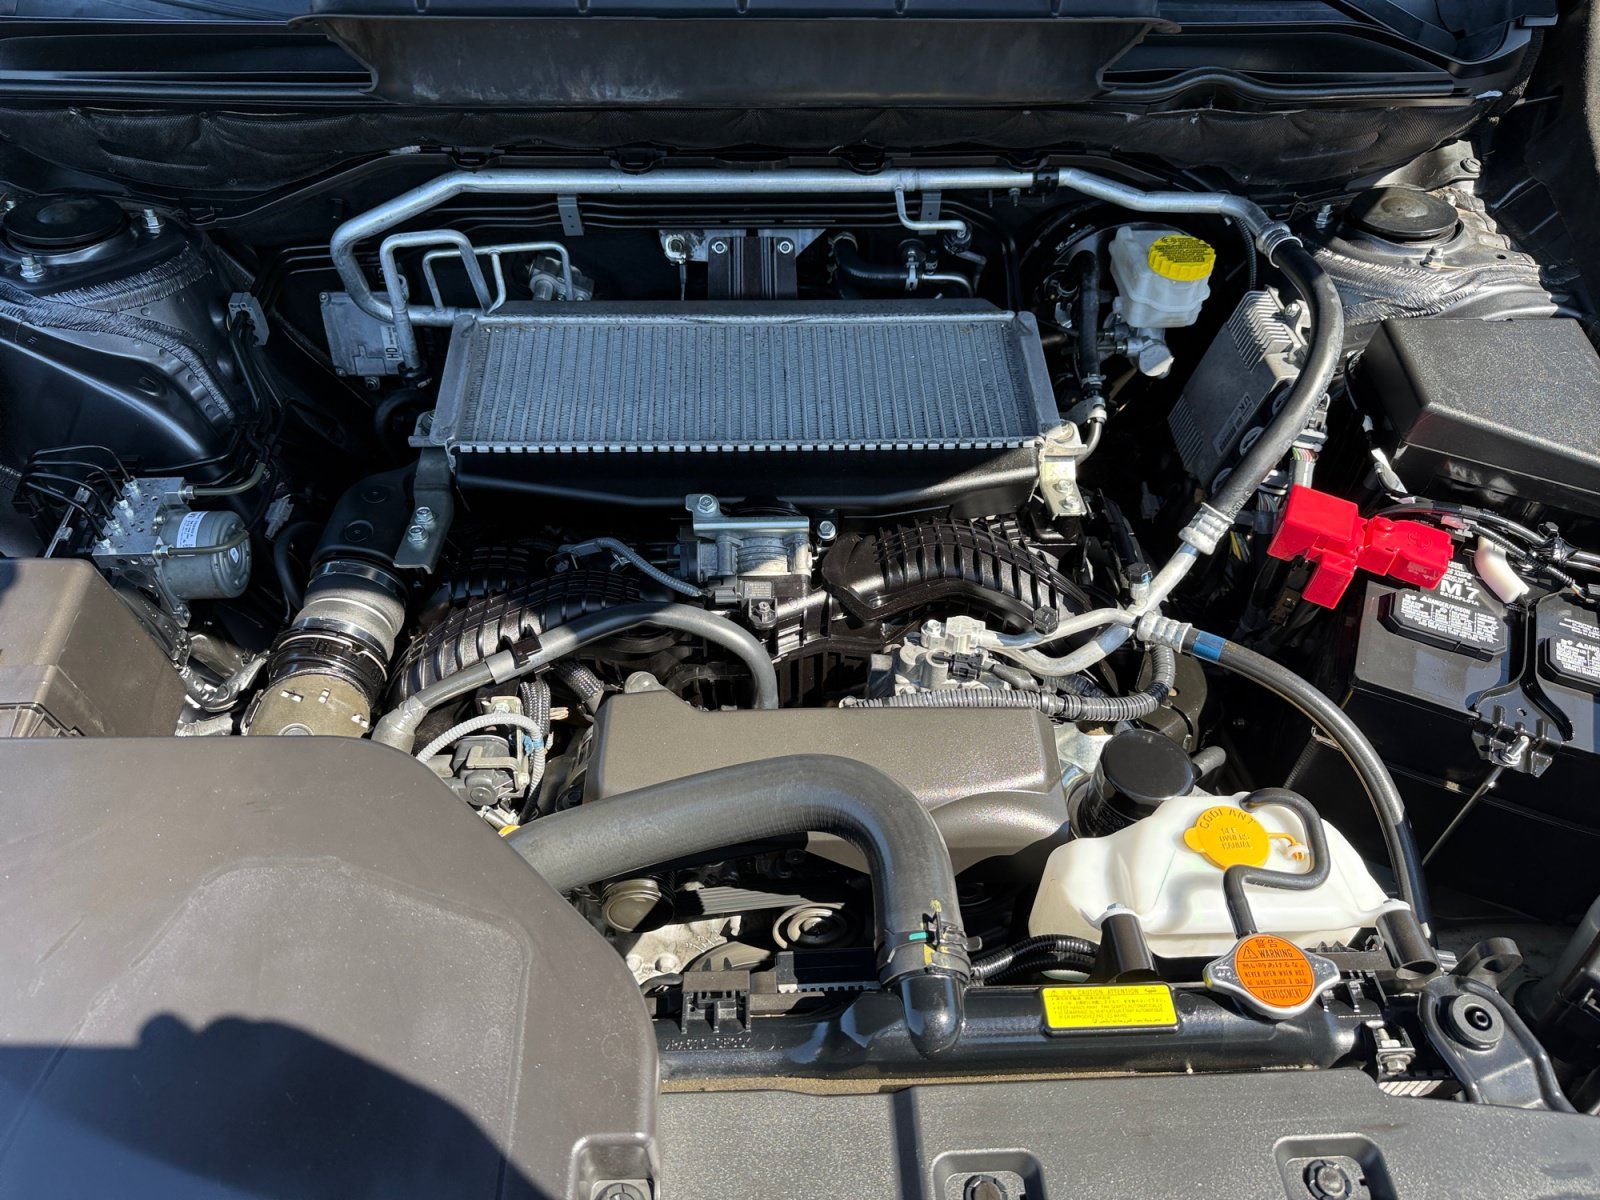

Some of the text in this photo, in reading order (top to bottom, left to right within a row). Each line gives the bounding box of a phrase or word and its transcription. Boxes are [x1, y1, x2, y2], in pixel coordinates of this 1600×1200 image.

[385, 347, 399, 359] HD
[1440, 579, 1480, 600] M 7
[1259, 948, 1294, 959] WARNING
[1264, 970, 1277, 978] OPEN
